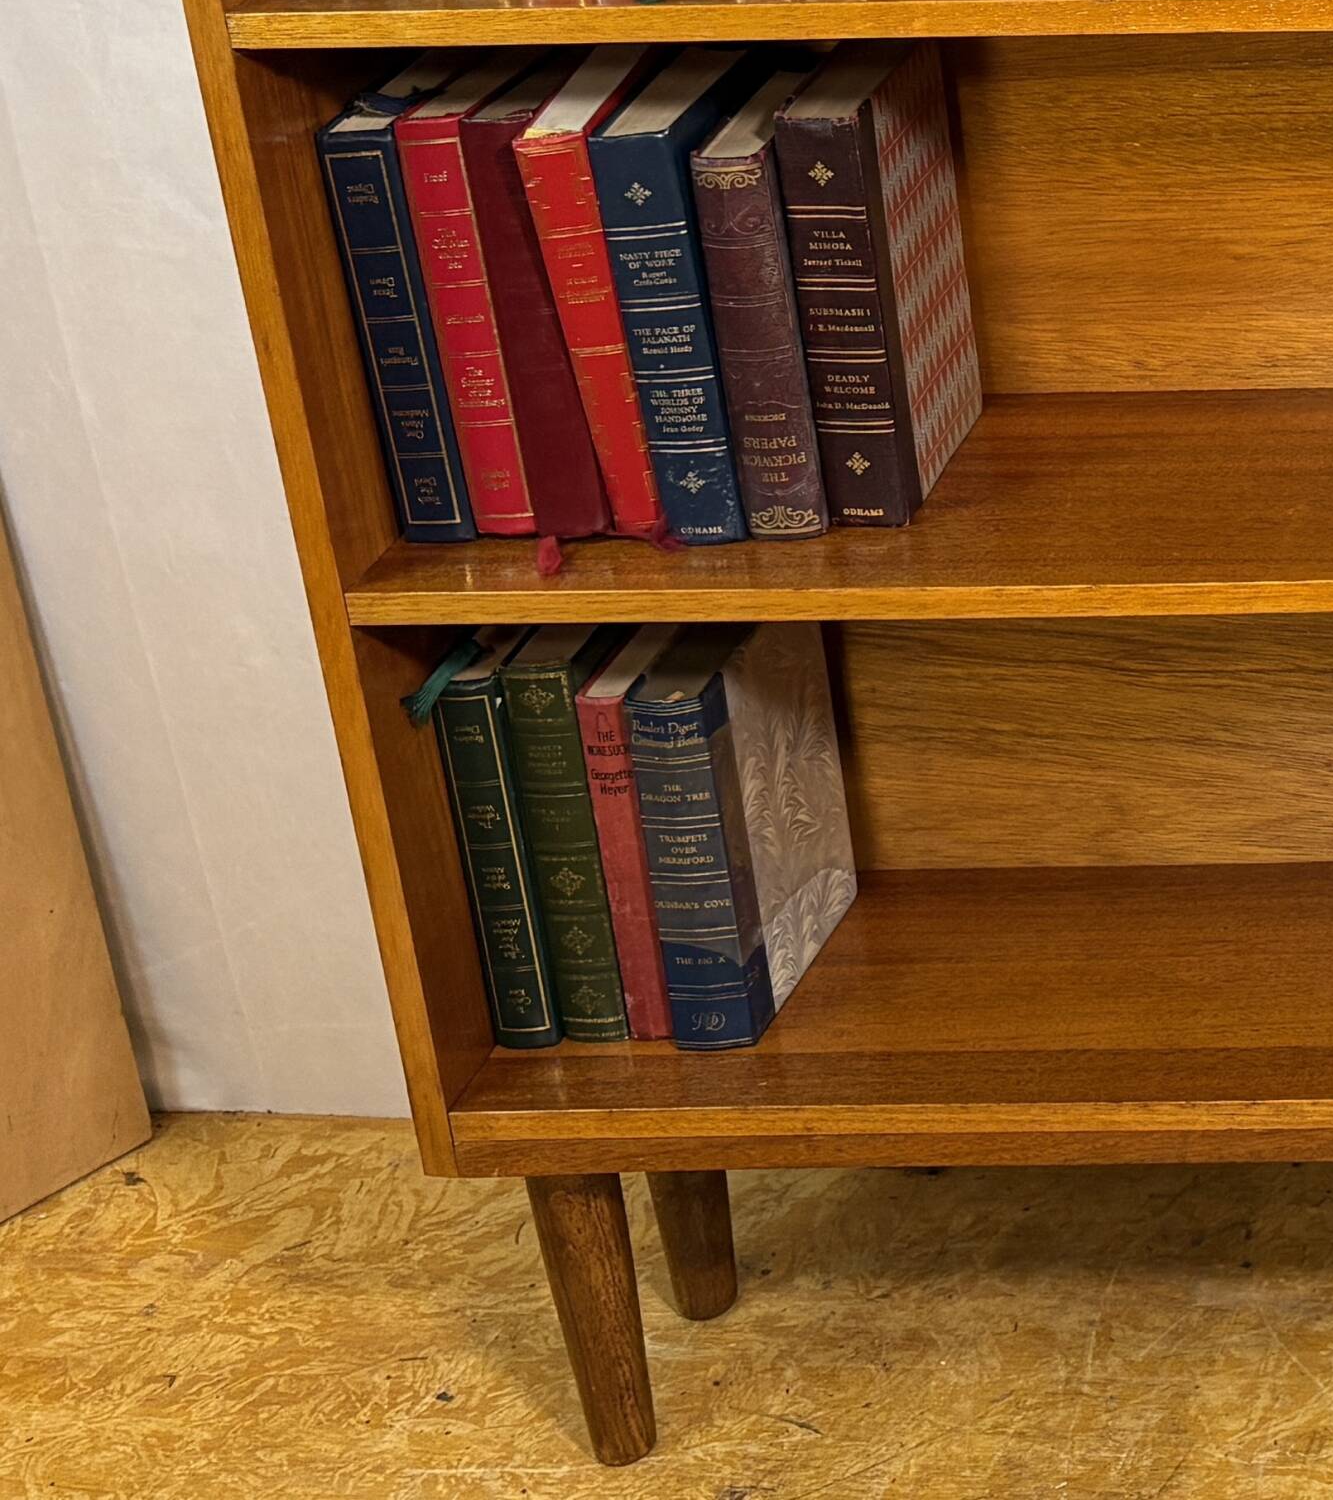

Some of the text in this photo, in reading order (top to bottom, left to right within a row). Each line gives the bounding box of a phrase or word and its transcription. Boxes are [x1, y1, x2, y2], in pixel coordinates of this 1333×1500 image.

[813, 230, 845, 238] VILLA
[809, 241, 853, 251] MIMOSA
[619, 249, 682, 261] NASTY PIECE
[632, 327, 650, 336] THE
[682, 324, 695, 332] OF
[827, 374, 870, 382] DEADLY
[650, 388, 704, 398] THE THREE
[823, 385, 877, 395] WELCOME
[650, 396, 705, 407] WORLDS OF
[660, 406, 699, 415] JOHNNY
[654, 413, 708, 423] HANDSOME
[742, 435, 796, 449] PAPERS
[760, 471, 788, 483] THE
[841, 508, 885, 516] ODHAMS
[680, 525, 724, 535] ODHAMS
[668, 722, 698, 734] Digest
[597, 731, 616, 743] THE
[600, 782, 629, 795] Heyer
[662, 784, 681, 792] THE
[640, 792, 712, 803] DRAGON TREE
[658, 834, 707, 842] TRUMPETS
[658, 856, 713, 864] MERRIFORD
[702, 899, 731, 909] COVE
[675, 955, 726, 965] THE BIG X
